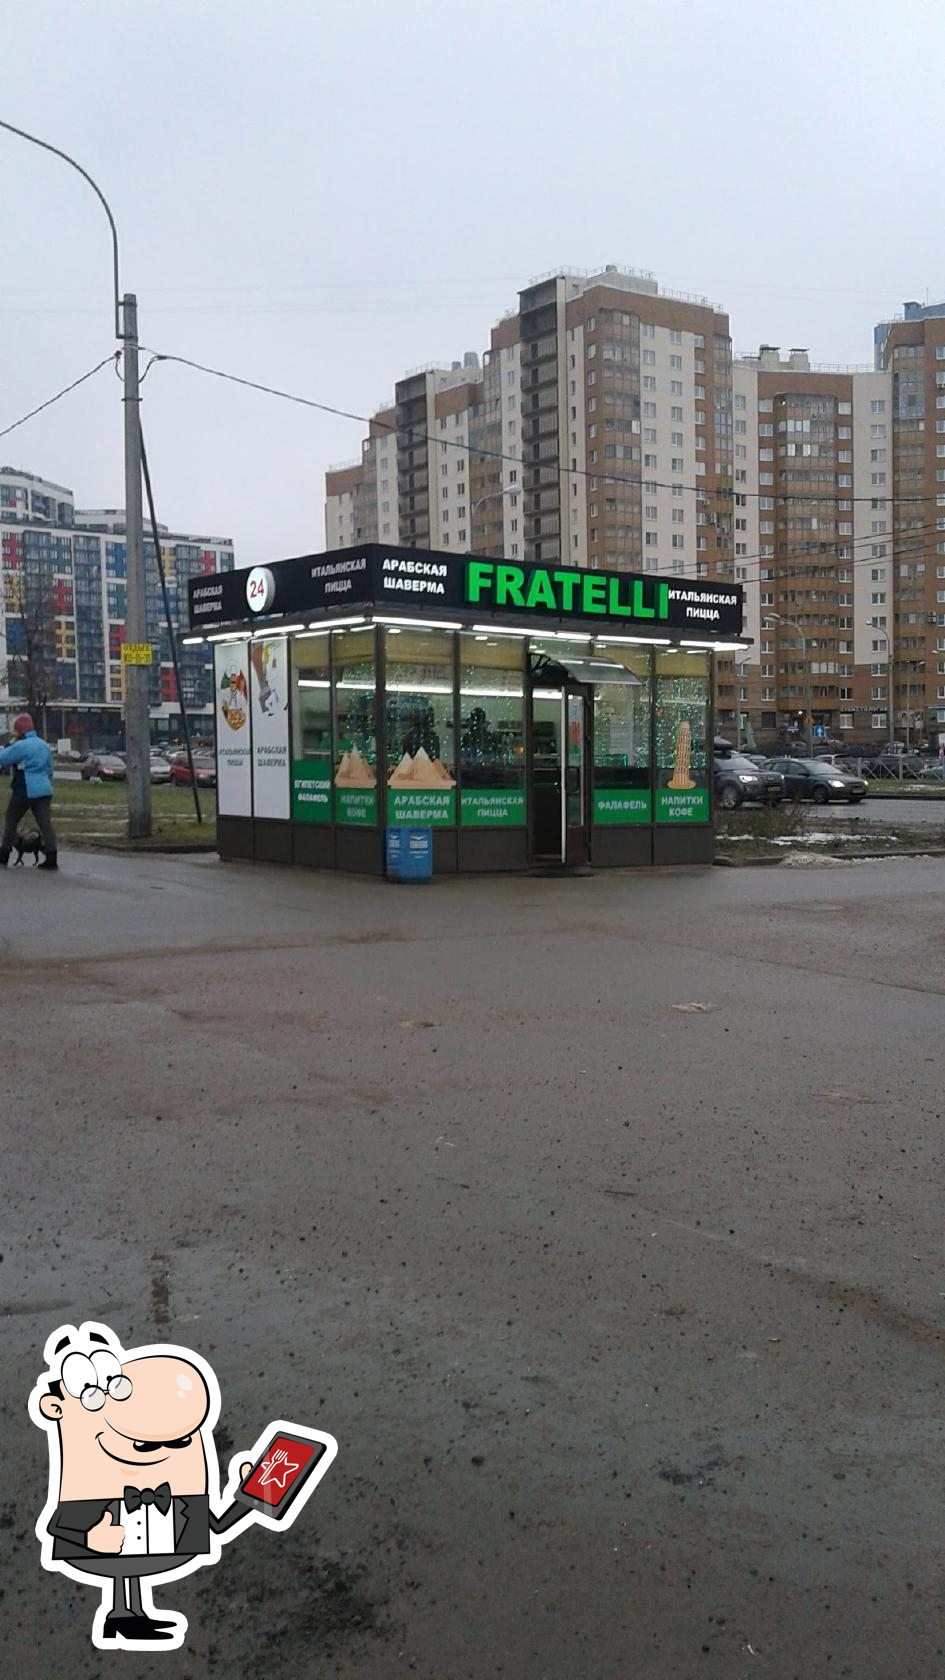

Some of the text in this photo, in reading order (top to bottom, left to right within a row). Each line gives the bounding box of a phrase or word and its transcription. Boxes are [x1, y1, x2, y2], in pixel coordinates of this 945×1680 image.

[311, 559, 366, 578] ИТАЛЬЯНСКАЯ
[382, 559, 447, 576] АРАБСКАЯ
[193, 585, 223, 598] АРАБСКАЯ
[250, 579, 265, 598] 24
[325, 580, 352, 593] ПИЦЦА
[384, 577, 445, 594] ШАВЕРМА
[466, 562, 669, 620] FRATELLI
[668, 590, 737, 606] ИТАЛЬЯНСКАЯ
[686, 607, 720, 620] ПИЦЦА
[257, 746, 287, 754] АРАБСКАЯ
[394, 796, 450, 806] АРАБСКАЯ
[461, 797, 524, 805] ИТАЛЬЯНСКАЯ
[598, 800, 647, 810] ФАЛАФЕЛЬ
[662, 796, 703, 805] НАПИТКИ
[396, 810, 448, 819] ШАВЕРМА
[478, 808, 508, 817] ПИЦЦА
[669, 808, 693, 816] КОФЕ
